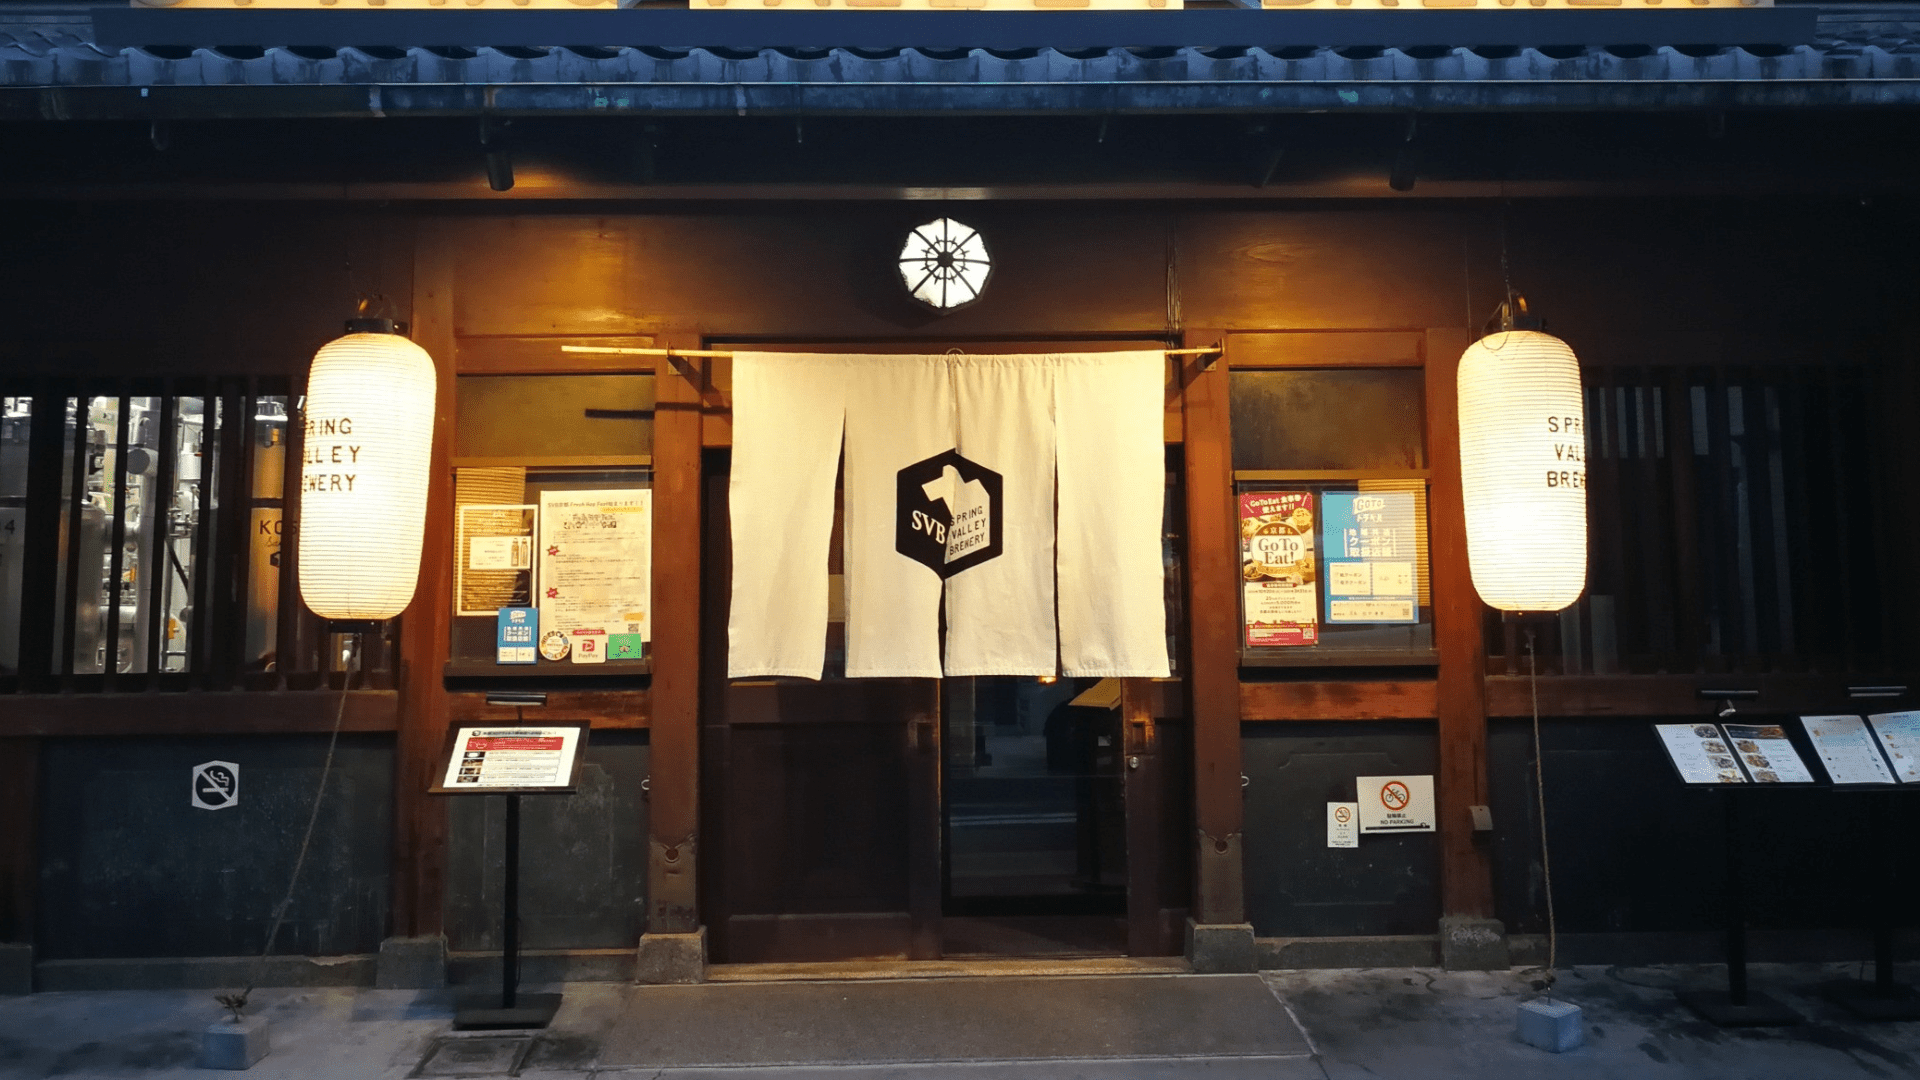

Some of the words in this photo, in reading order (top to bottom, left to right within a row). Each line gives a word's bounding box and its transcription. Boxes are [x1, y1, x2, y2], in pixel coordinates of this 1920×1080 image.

[912, 509, 946, 545] SVB
[950, 505, 984, 527] SPRING
[951, 517, 987, 540] VALLEY
[949, 531, 986, 556] BREWERY
[1264, 551, 1295, 565] Eat!
